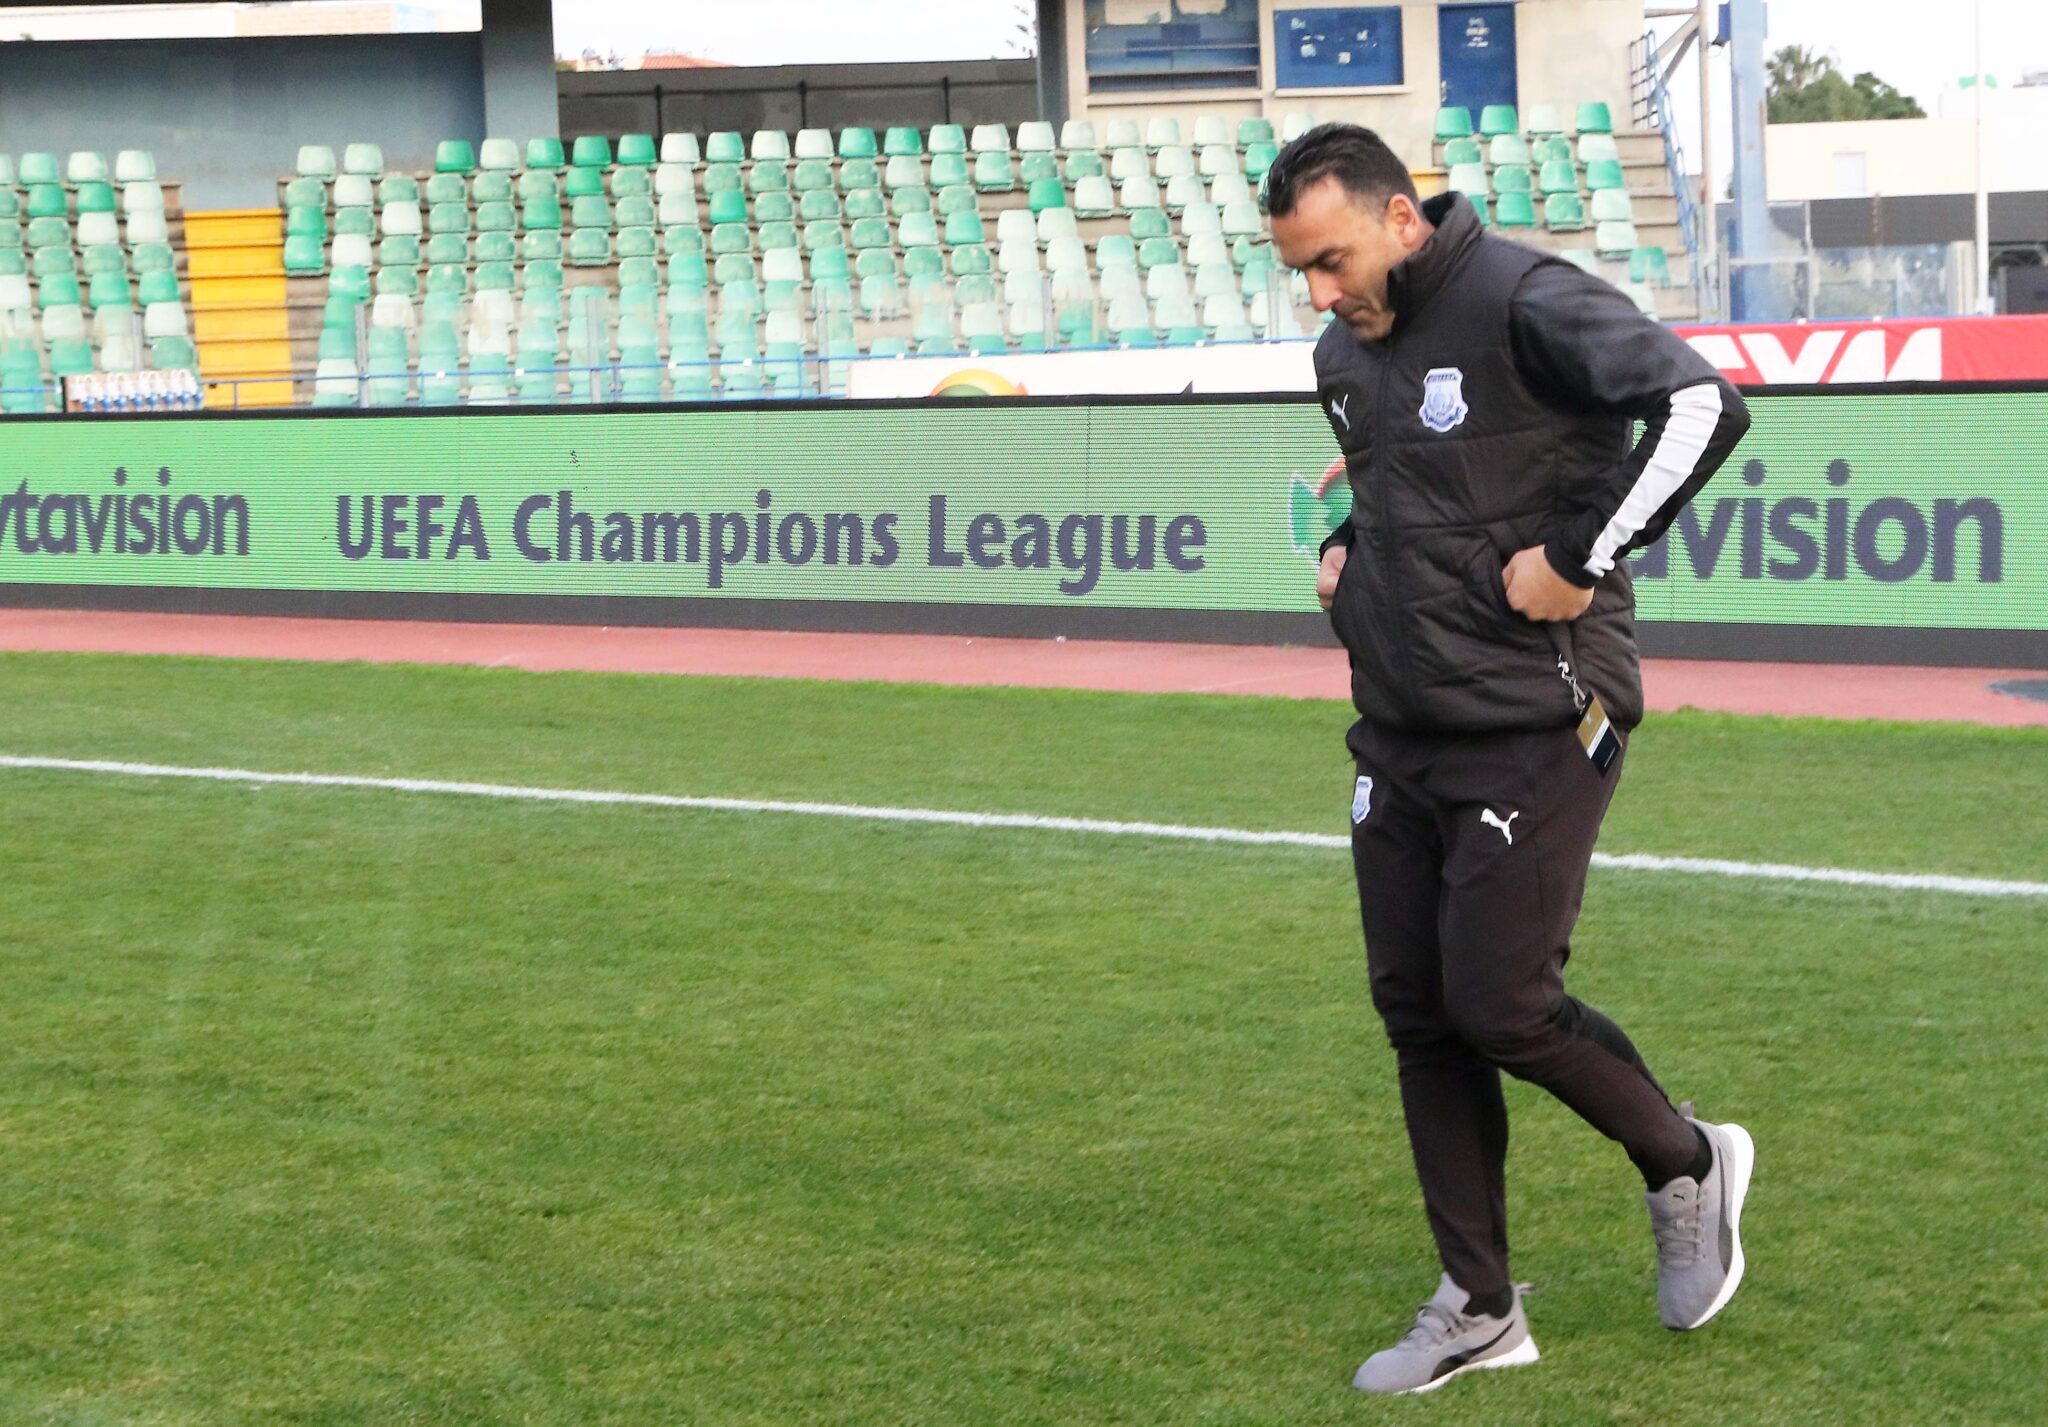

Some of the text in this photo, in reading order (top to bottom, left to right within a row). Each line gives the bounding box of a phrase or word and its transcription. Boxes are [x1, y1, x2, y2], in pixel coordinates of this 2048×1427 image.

[337, 489, 1207, 596] UEFA Champions League
